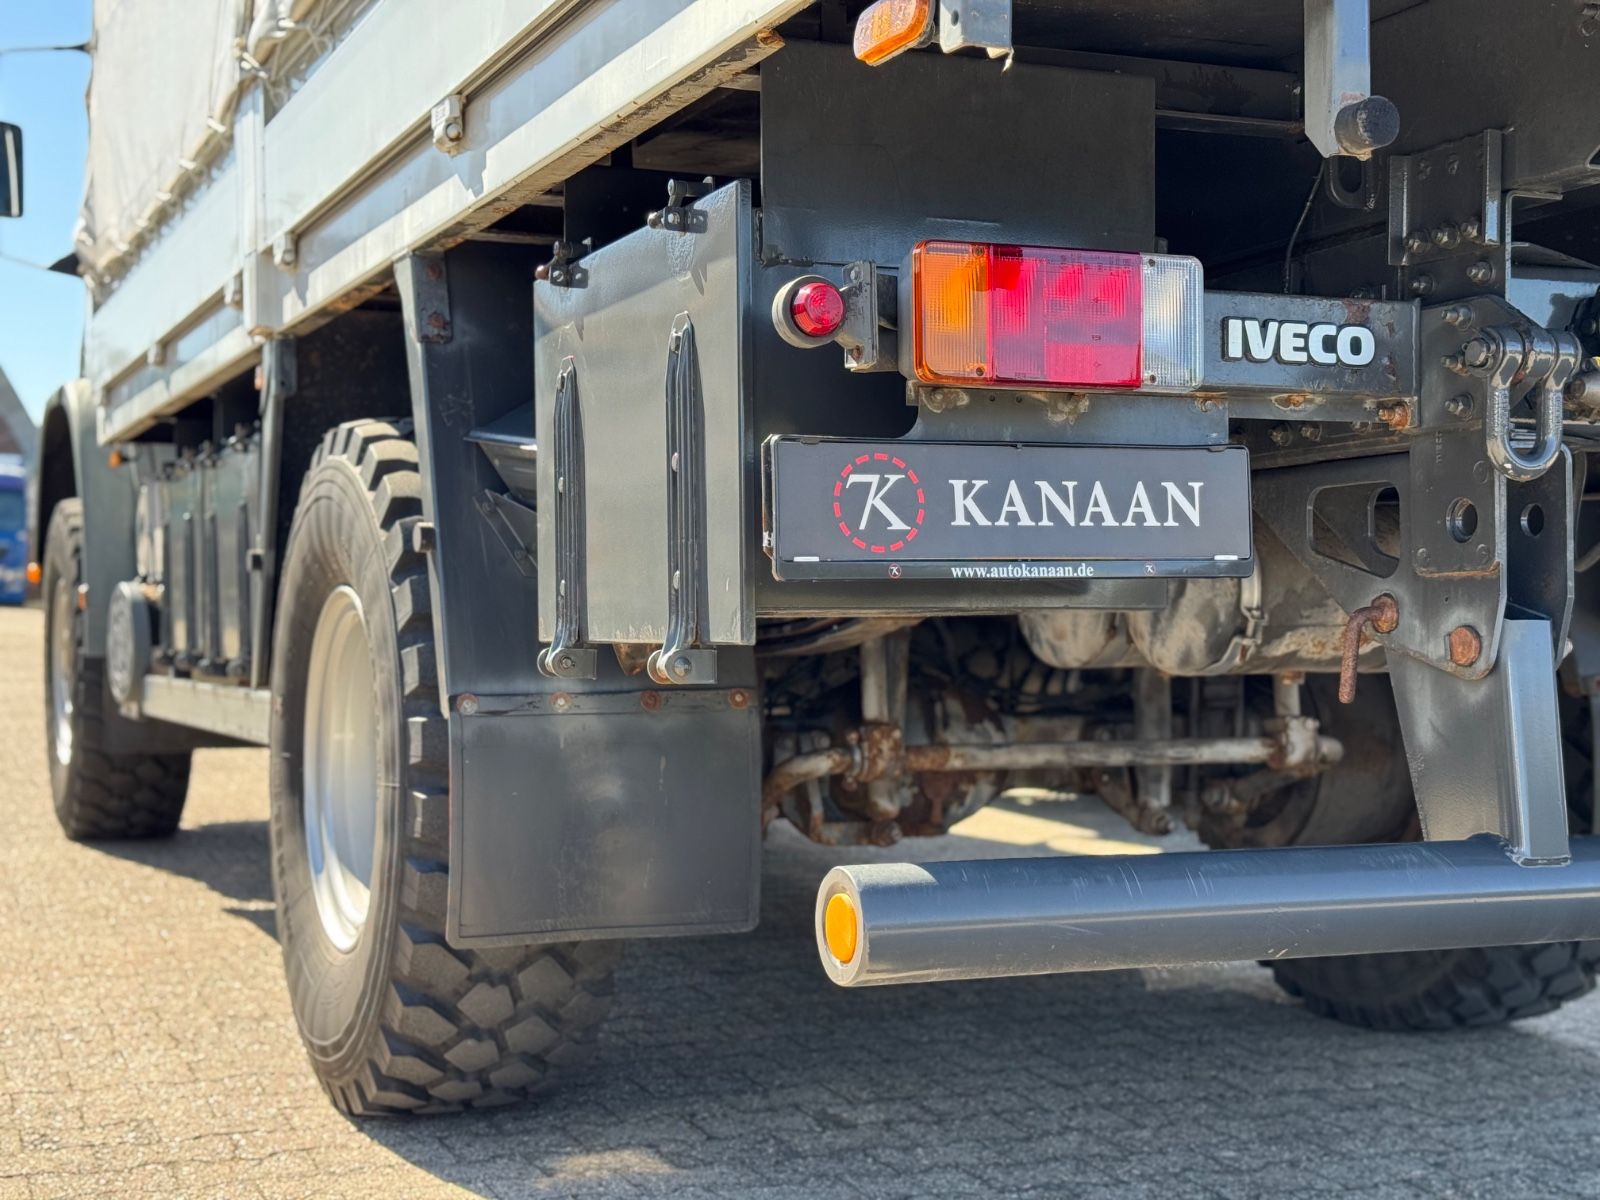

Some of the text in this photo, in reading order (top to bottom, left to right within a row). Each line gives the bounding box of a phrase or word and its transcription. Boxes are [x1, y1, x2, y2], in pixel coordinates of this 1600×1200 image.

[1227, 318, 1375, 366] IVECO
[949, 479, 1205, 528] KANAAN
[950, 563, 1095, 579] www.autokanaan.de
